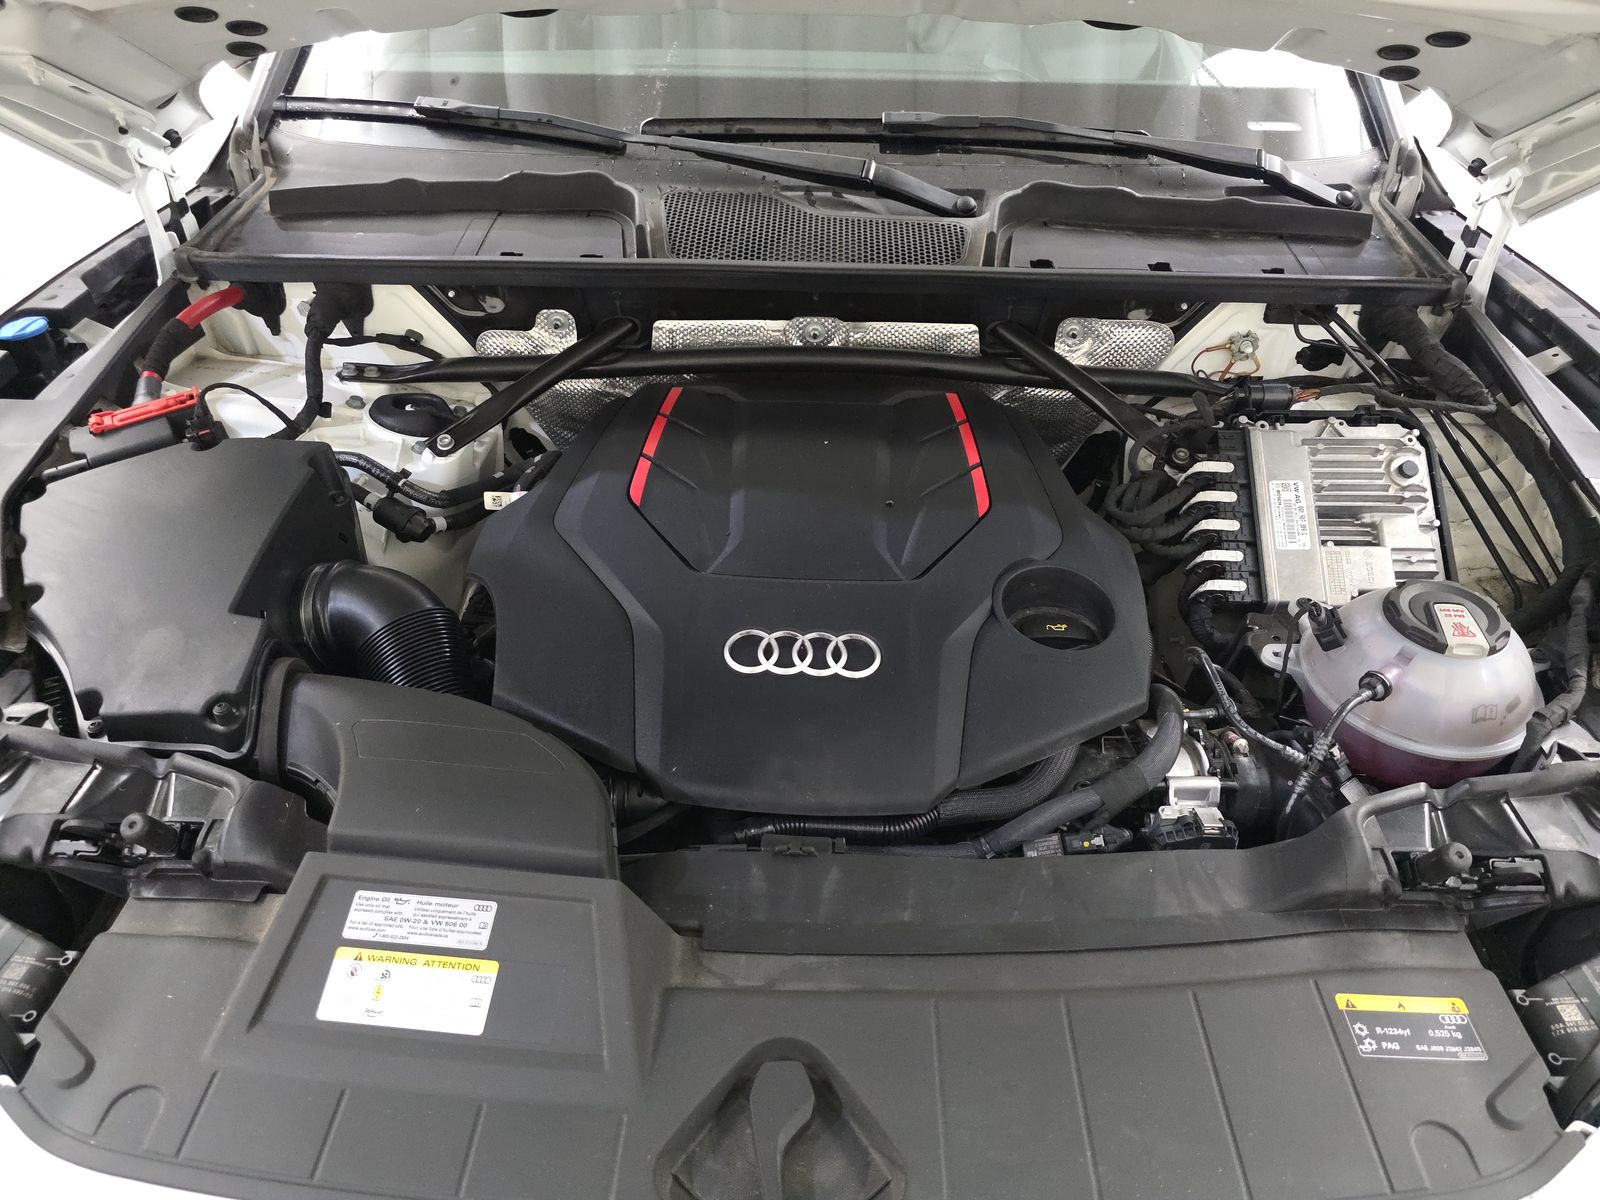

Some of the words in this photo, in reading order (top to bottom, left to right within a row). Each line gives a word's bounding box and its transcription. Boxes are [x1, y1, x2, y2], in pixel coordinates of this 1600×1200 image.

[1293, 482, 1300, 493] VW
[1294, 494, 1301, 504] AG
[367, 954, 417, 966] WARNING
[423, 960, 481, 972] ATTENTION
[1428, 1029, 1450, 1038] 0,525
[1451, 1030, 1462, 1039] kg
[1382, 1042, 1400, 1050] PAG
